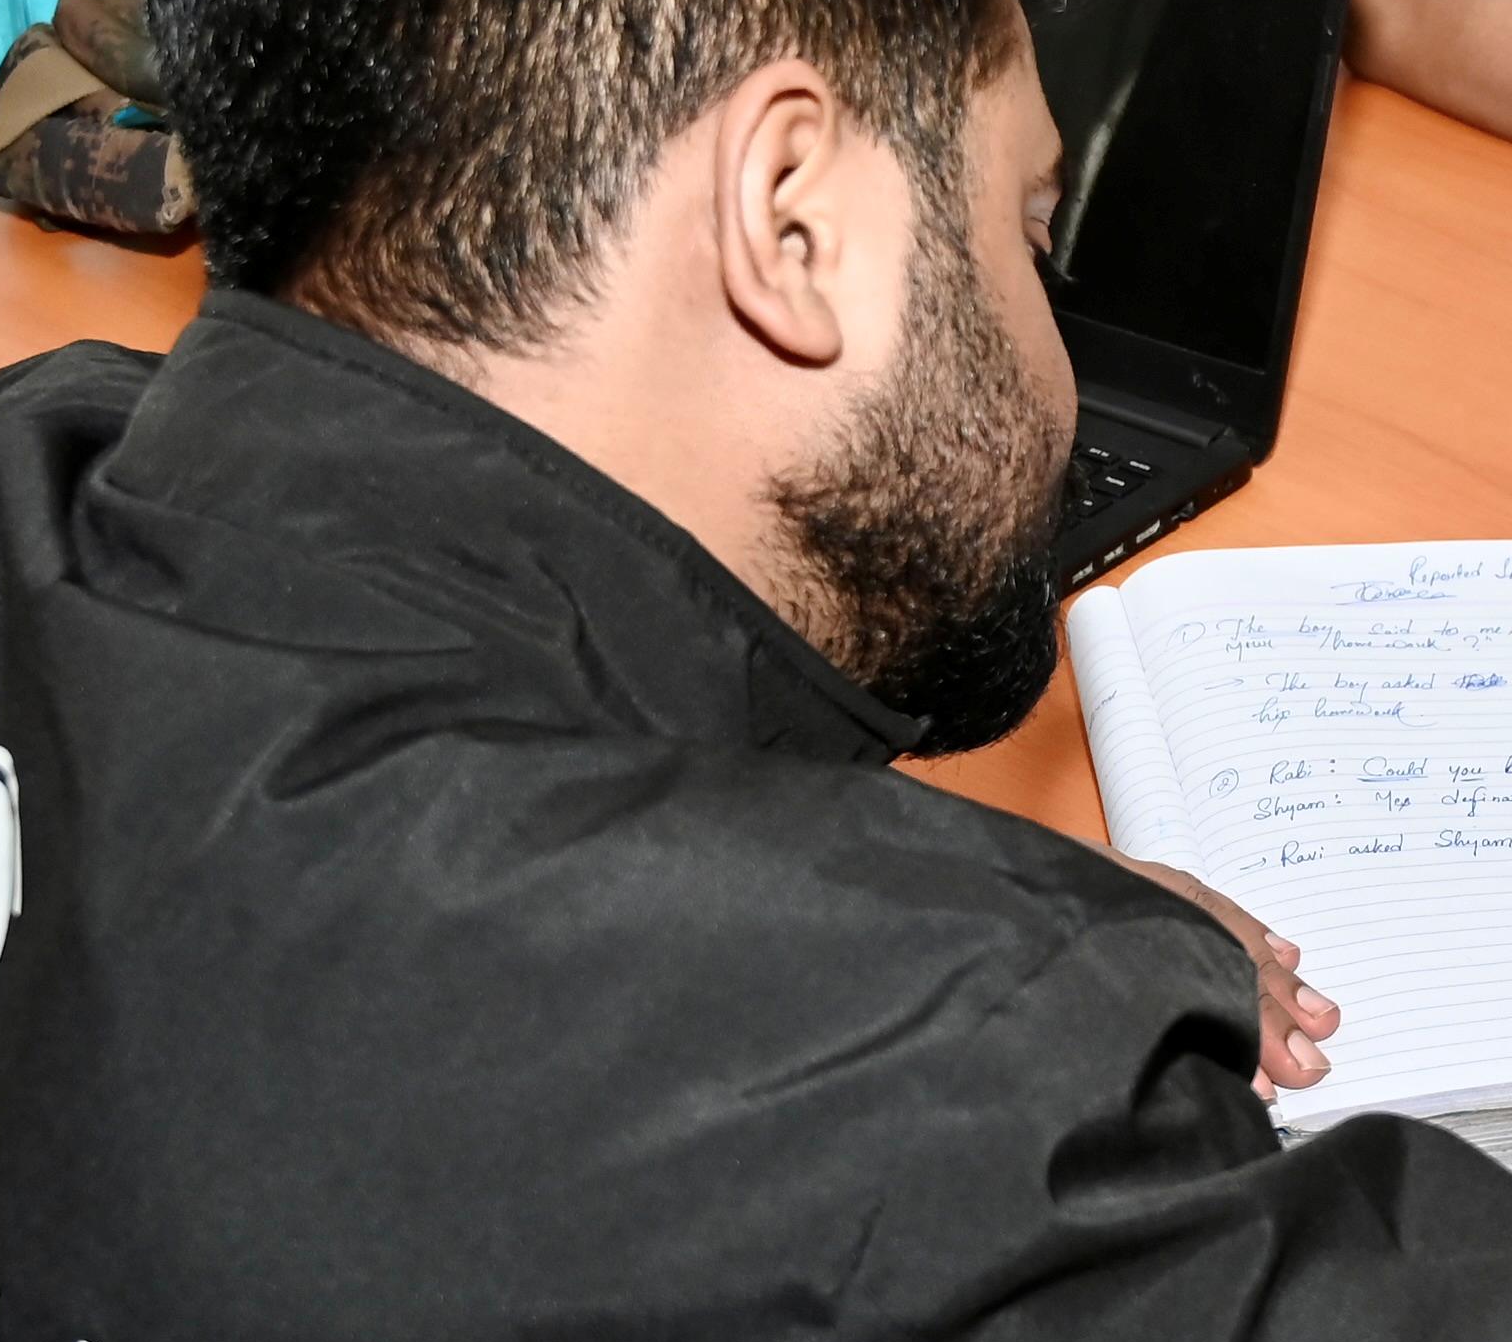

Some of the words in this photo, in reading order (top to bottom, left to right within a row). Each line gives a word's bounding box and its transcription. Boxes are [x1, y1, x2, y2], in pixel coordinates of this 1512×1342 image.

[1215, 615, 1267, 640] The
[1298, 615, 1335, 648] boy
[1433, 620, 1460, 636] to
[1265, 672, 1309, 693] The
[1334, 672, 1369, 704] boy
[1381, 672, 1436, 691] asked
[1359, 756, 1429, 781] Could
[1448, 763, 1485, 783] you
[1375, 790, 1411, 811] Yes
[1280, 840, 1326, 868] Ravi
[1348, 833, 1404, 856] asked
